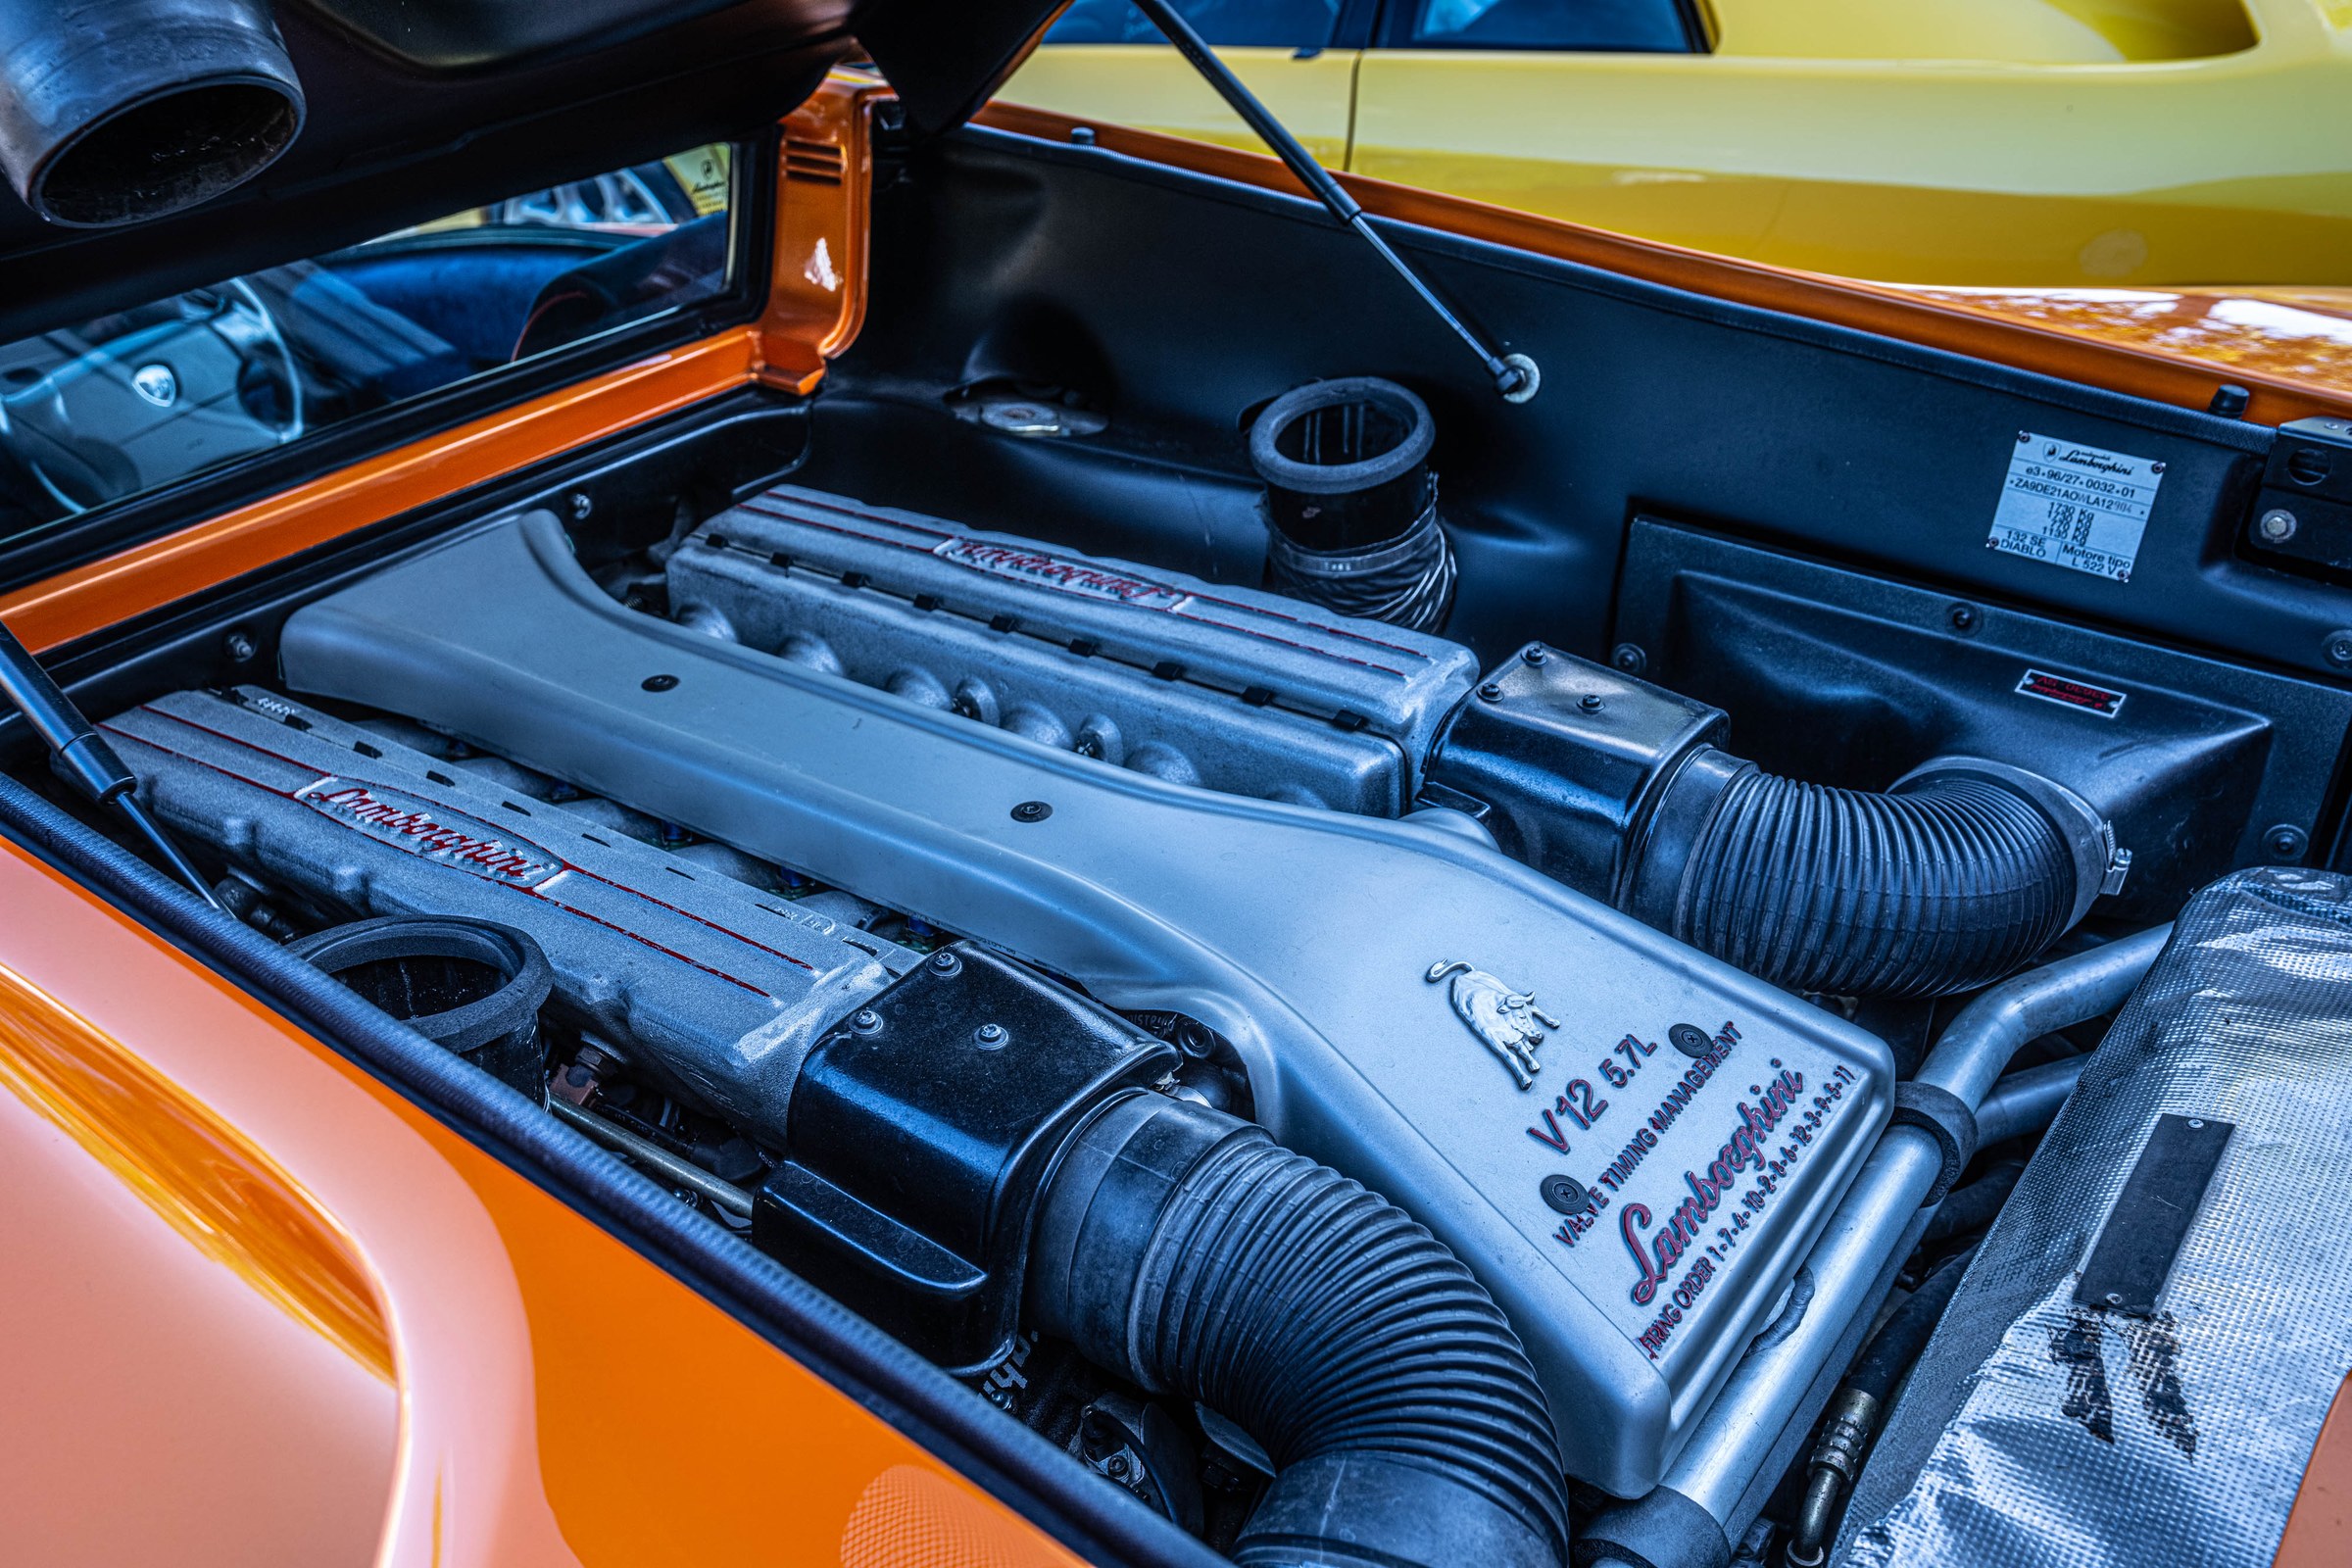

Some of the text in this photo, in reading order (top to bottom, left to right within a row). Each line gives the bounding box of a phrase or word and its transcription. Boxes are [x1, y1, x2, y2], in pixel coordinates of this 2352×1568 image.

[2059, 448, 2134, 476] Lamborghini
[2049, 502, 2095, 521] 1730 Kg
[1999, 538, 2046, 558] DIABLO
[2006, 530, 2046, 547] 132 SE
[2062, 544, 2131, 570] Motore tipo
[955, 542, 1174, 599] Lamborghini
[2072, 559, 2119, 576] L 522 V
[307, 787, 549, 879] Lamborghini
[1526, 1032, 1659, 1156] V12 5.7L
[1597, 1126, 1660, 1195] TIMING
[1647, 1019, 1744, 1135] MANAGEMENT
[1620, 1057, 1806, 1306] Lamborghini
[1637, 1301, 1685, 1361] FIRING
[1672, 1254, 1718, 1312] ORDER
